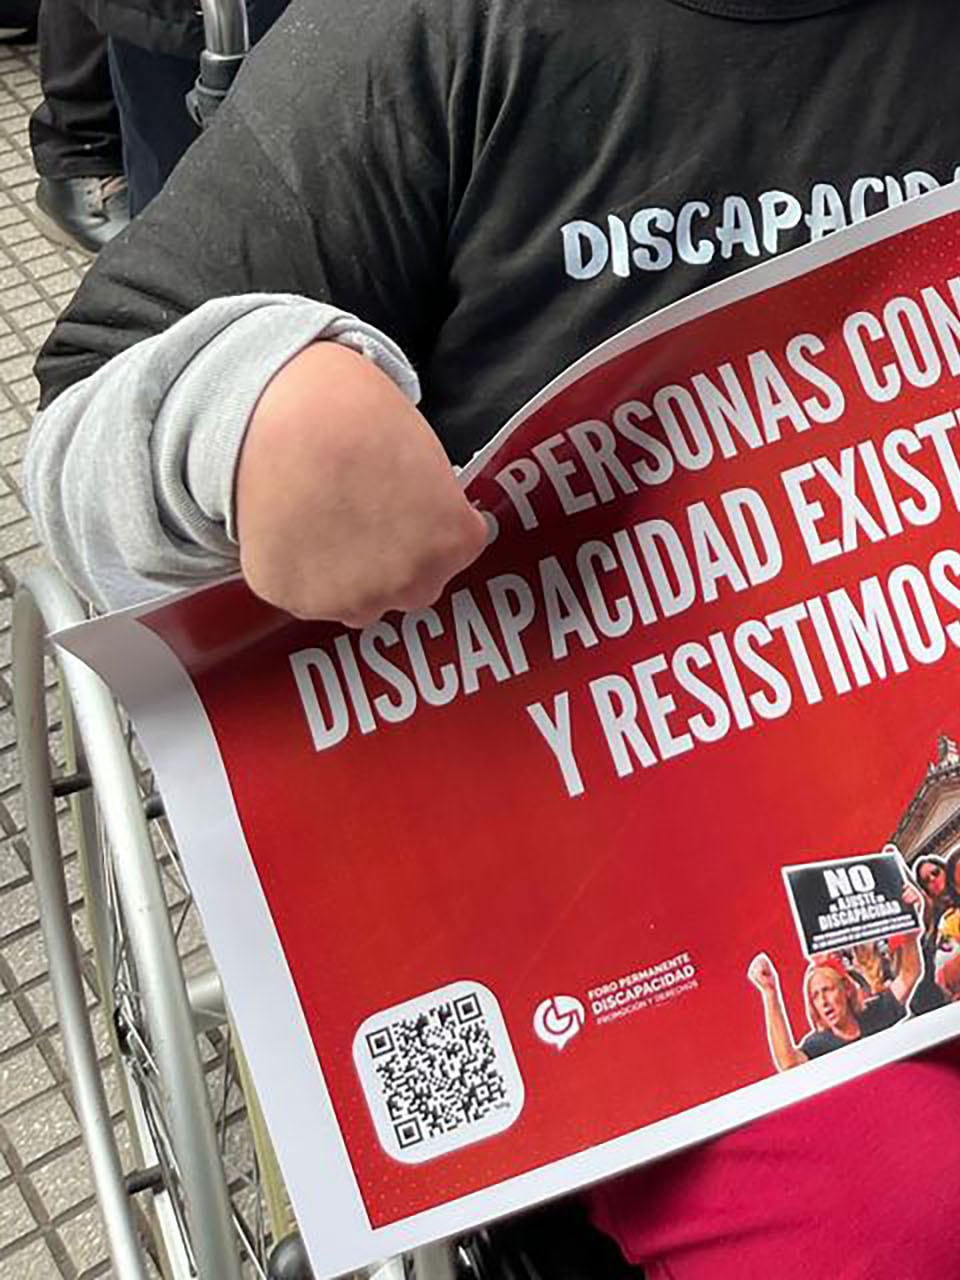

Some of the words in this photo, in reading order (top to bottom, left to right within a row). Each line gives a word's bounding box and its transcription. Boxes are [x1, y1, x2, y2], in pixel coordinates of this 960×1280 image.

[494, 332, 846, 532] PERSONAS
[287, 486, 784, 754] DISCAPACIDAD
[527, 692, 587, 800] Y
[823, 864, 876, 899] NO
[592, 964, 696, 1016] DISCAPACIDAD
